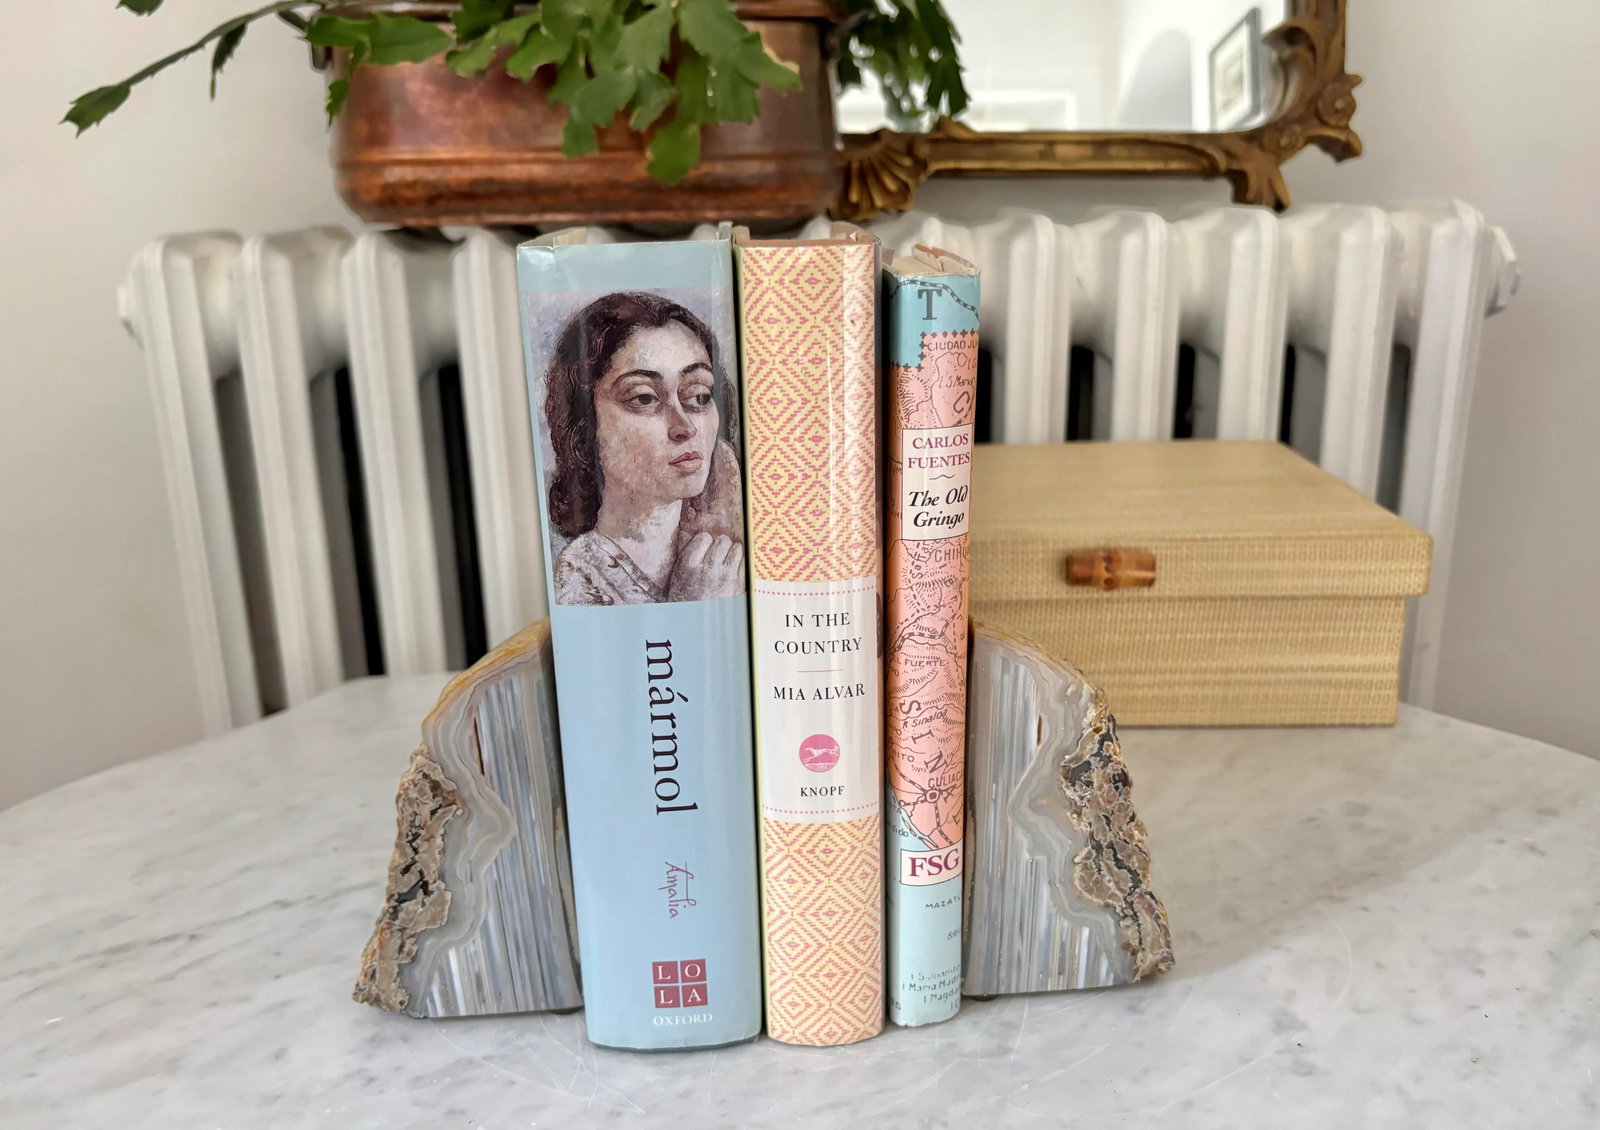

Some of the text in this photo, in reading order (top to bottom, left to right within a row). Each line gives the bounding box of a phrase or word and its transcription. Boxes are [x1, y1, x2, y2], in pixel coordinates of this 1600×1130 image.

[917, 288, 943, 320] T
[927, 340, 966, 352] CIUDAD
[912, 433, 969, 450] CARLOS
[908, 452, 970, 469] FUENTES
[908, 490, 940, 507] The
[945, 484, 969, 505] Old
[913, 511, 965, 530] Gringo
[785, 612, 851, 628] IN THE
[774, 637, 862, 655] COUNTRY
[773, 683, 865, 701] MIA ALVAR
[645, 639, 699, 816] mármol
[800, 785, 845, 797] KNOPF
[908, 848, 960, 877] FSG
[658, 861, 697, 919] Amalia
[652, 1013, 714, 1028] OXFORD
